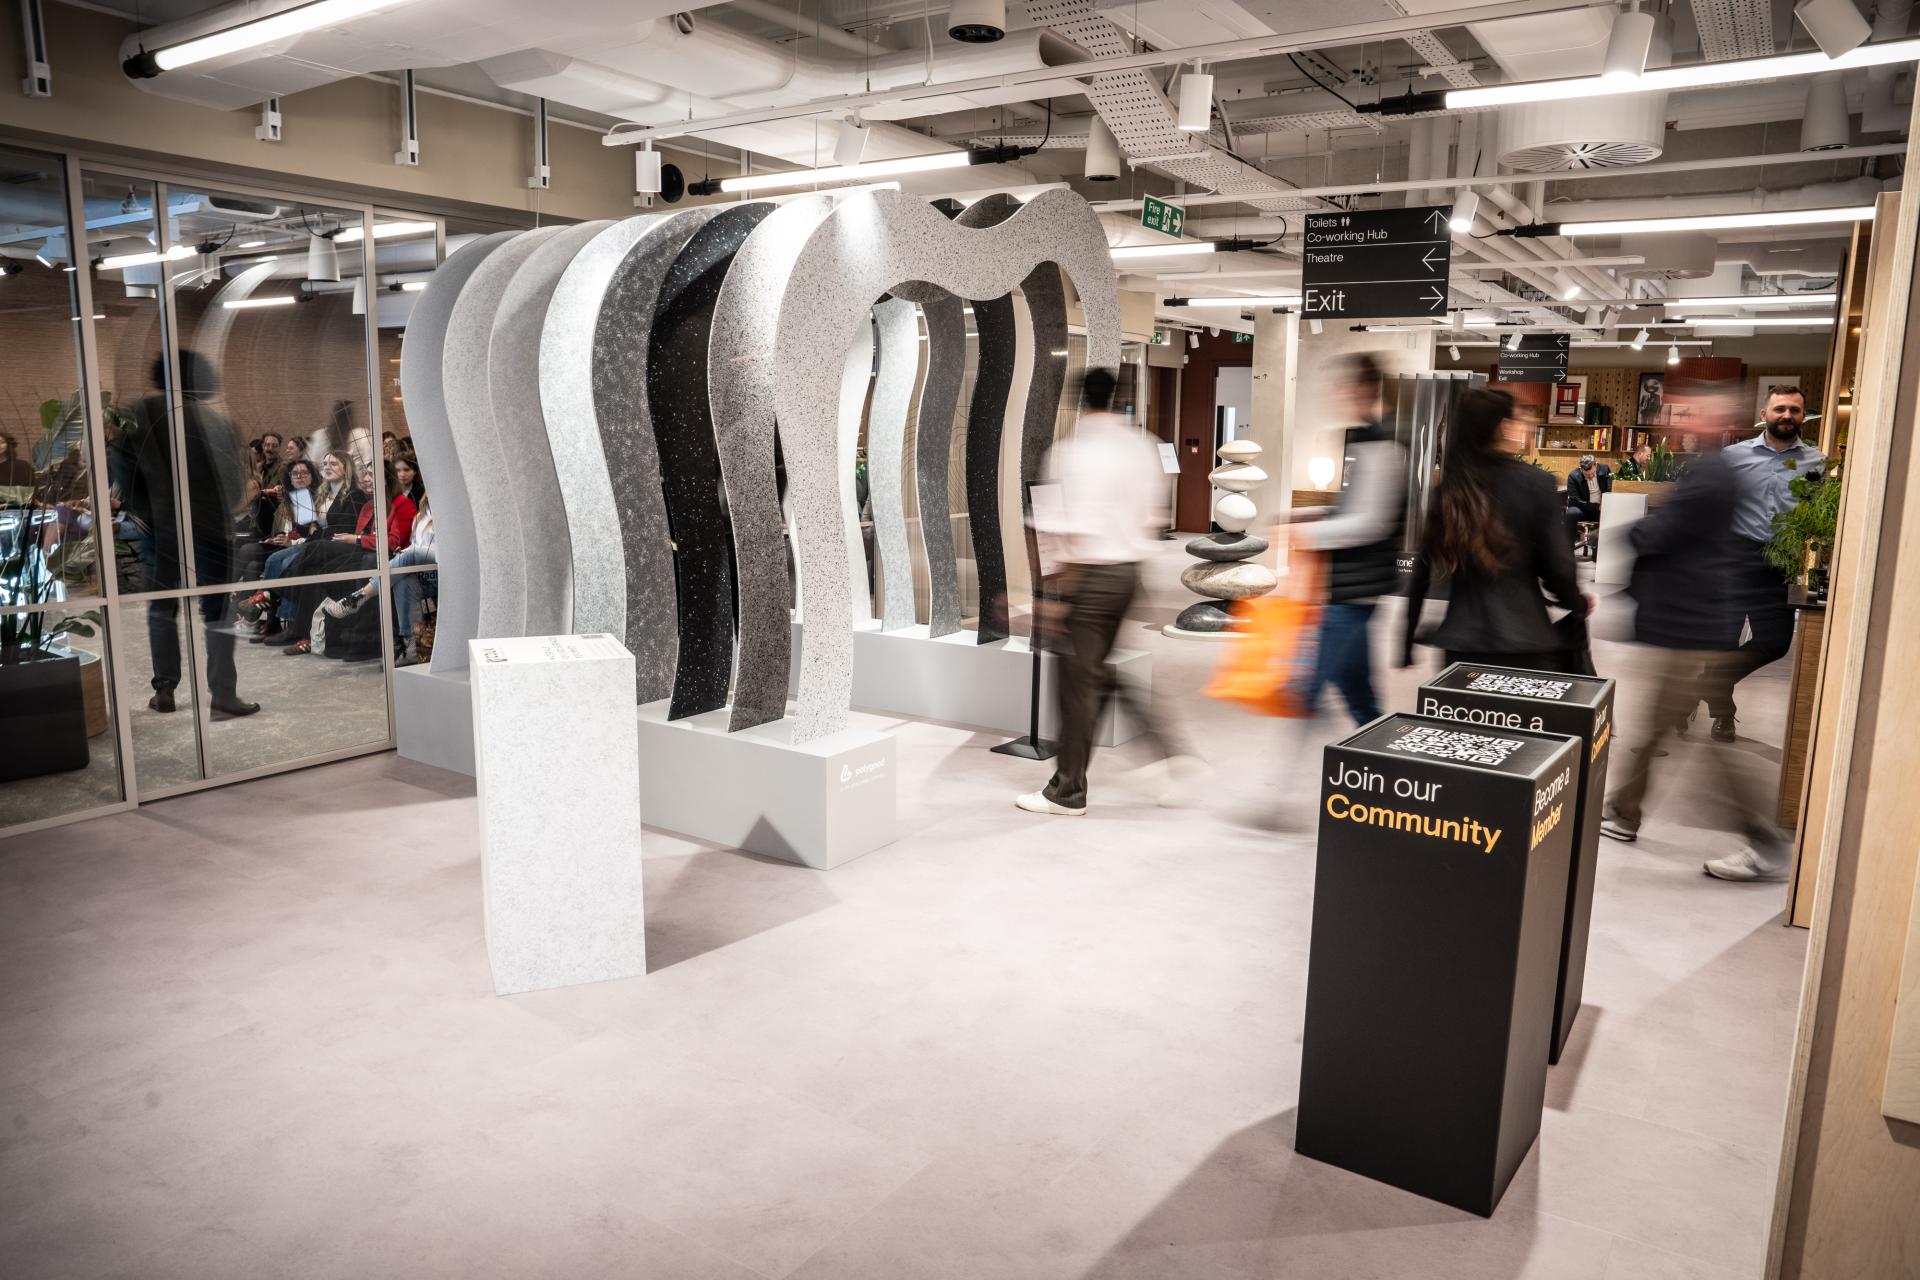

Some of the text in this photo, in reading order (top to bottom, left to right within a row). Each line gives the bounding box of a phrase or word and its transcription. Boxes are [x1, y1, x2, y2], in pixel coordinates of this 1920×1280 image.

[1149, 202, 1160, 215] Fire
[1147, 216, 1159, 227] exit
[1307, 218, 1337, 229] Toilets
[1306, 229, 1388, 243] Co-working Hub
[1306, 253, 1344, 263] Theatre
[1305, 289, 1346, 312] Exit
[1423, 698, 1544, 732] Become a
[1328, 761, 1443, 803] Join our
[1534, 767, 1570, 817] Become a
[1326, 793, 1502, 854] Community
[1530, 801, 1563, 850] Member
